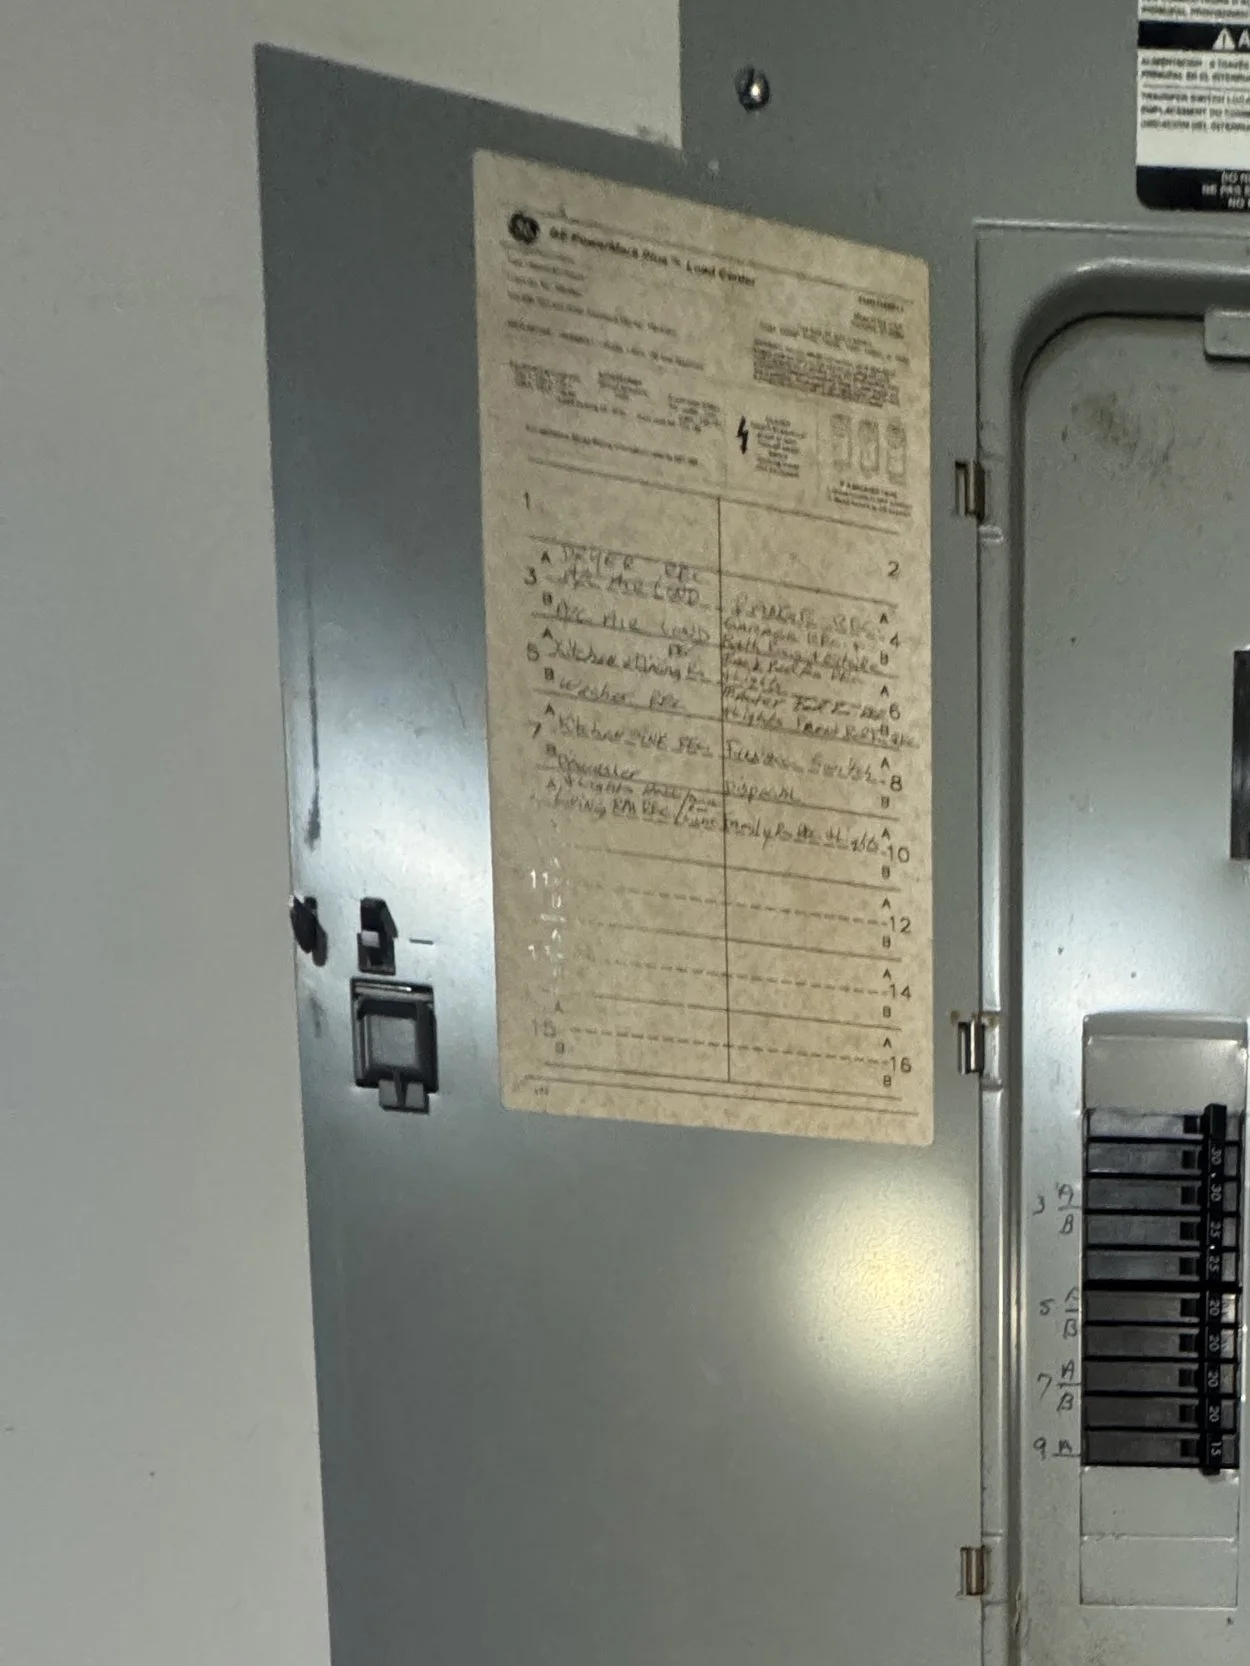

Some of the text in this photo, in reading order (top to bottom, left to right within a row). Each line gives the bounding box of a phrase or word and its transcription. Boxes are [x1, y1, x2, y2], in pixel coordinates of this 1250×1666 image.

[524, 565, 538, 586] 3
[887, 560, 900, 578] 2
[889, 632, 901, 649] 4
[889, 702, 901, 721] 6
[528, 719, 542, 740] 7
[889, 774, 903, 792] 8
[888, 844, 911, 864] 10
[889, 915, 912, 934] 12
[889, 983, 912, 1001] 14
[890, 1055, 913, 1074] 16
[1210, 1184, 1222, 1202] 30
[1059, 1213, 1075, 1236] B
[1208, 1298, 1220, 1317] 20
[1063, 1318, 1078, 1340] B
[1208, 1334, 1220, 1352] 20
[1060, 1359, 1076, 1381] A
[1036, 1372, 1053, 1401] 7
[1207, 1371, 1219, 1389] 20
[1056, 1391, 1074, 1413] B
[1208, 1406, 1220, 1423] 20
[1033, 1437, 1047, 1462] 9
[1210, 1441, 1223, 1457] 15
